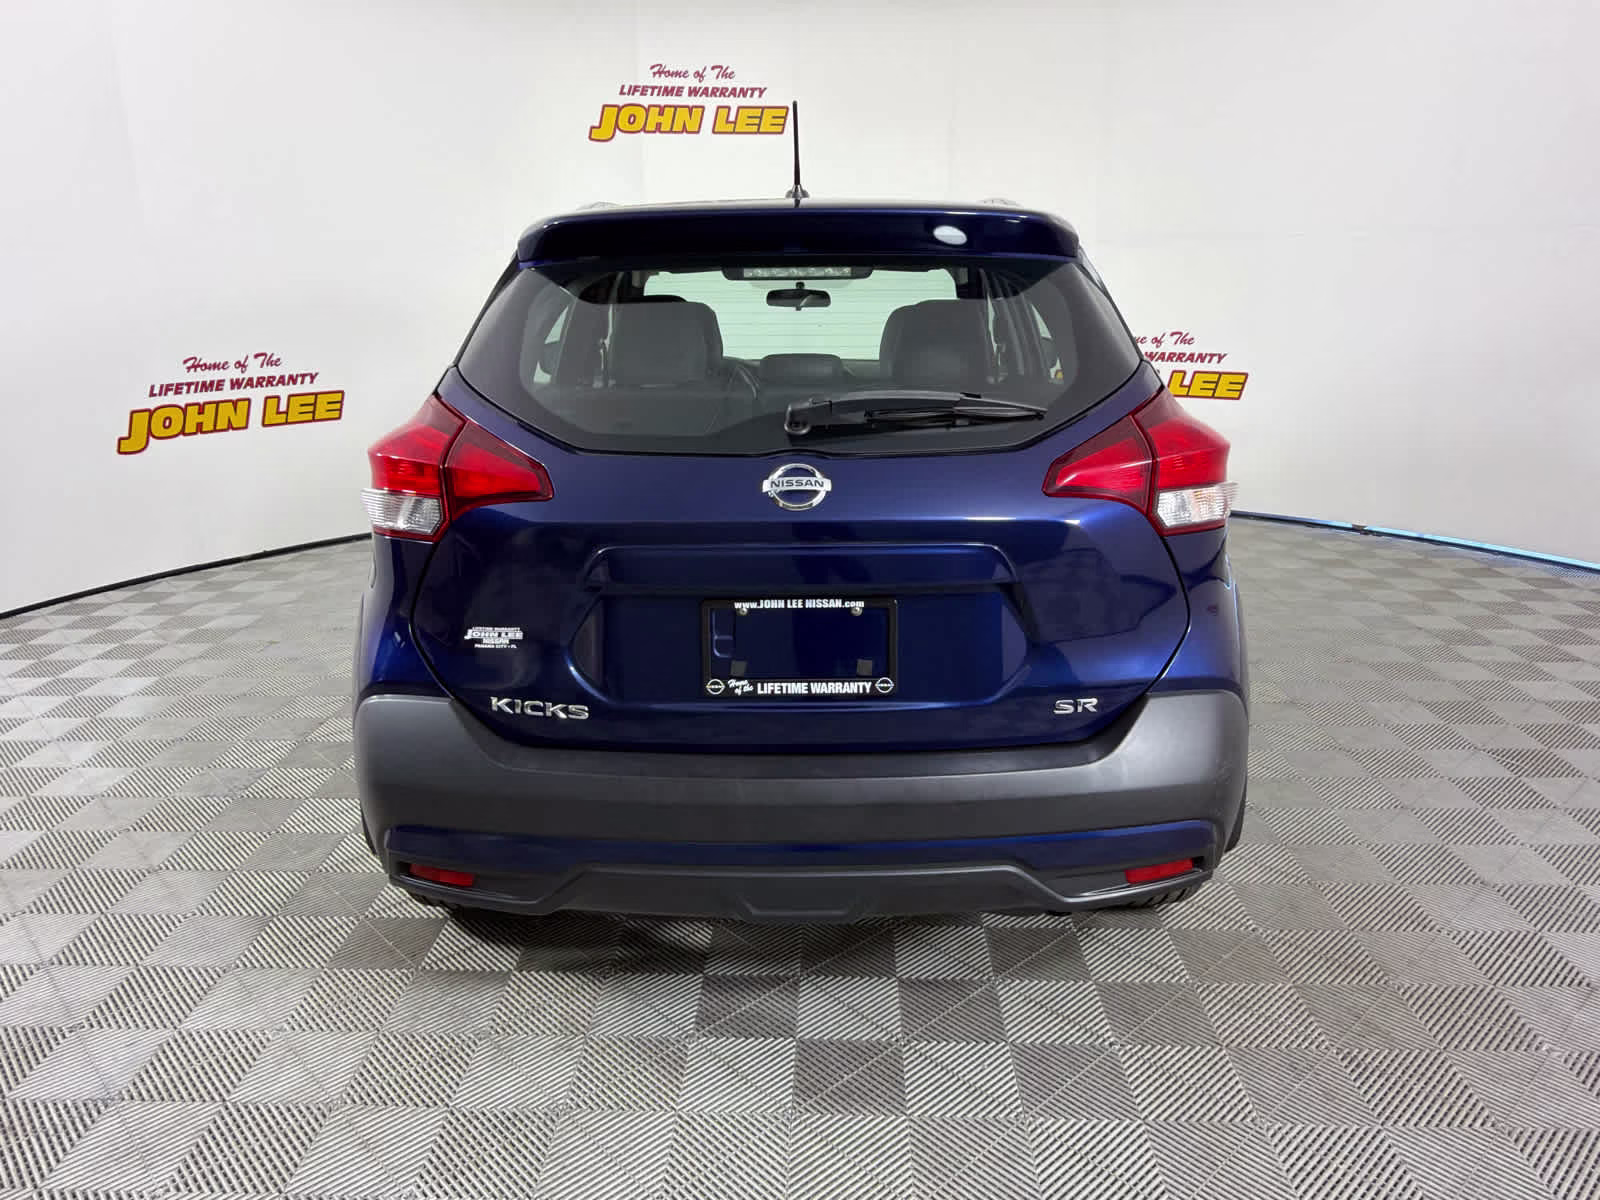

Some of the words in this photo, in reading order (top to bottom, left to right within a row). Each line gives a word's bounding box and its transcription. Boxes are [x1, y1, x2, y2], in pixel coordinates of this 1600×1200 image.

[650, 63, 689, 79] Home
[693, 66, 705, 83] of
[711, 65, 735, 80] The
[619, 84, 685, 97] LIFETIME
[688, 86, 767, 98] WARRANTY
[588, 103, 705, 142] JOHN
[712, 106, 789, 134] LEE
[1151, 332, 1166, 348] of
[1169, 331, 1195, 345] The
[183, 356, 230, 373] Home
[234, 355, 249, 373] of
[253, 352, 281, 369] The
[1144, 351, 1227, 364] WARRANTY
[149, 379, 225, 398] LIFETIME
[230, 372, 319, 391] WARRANTY
[1167, 370, 1249, 400] LEE
[116, 398, 251, 455] JOHN
[262, 390, 345, 427] LEE
[770, 479, 824, 488] NISSAN
[787, 600, 804, 609] LEE
[757, 682, 808, 694] LIFETIME
[810, 681, 872, 694] WARRANTY
[490, 696, 590, 720] KICKS
[1053, 697, 1098, 715] SR
